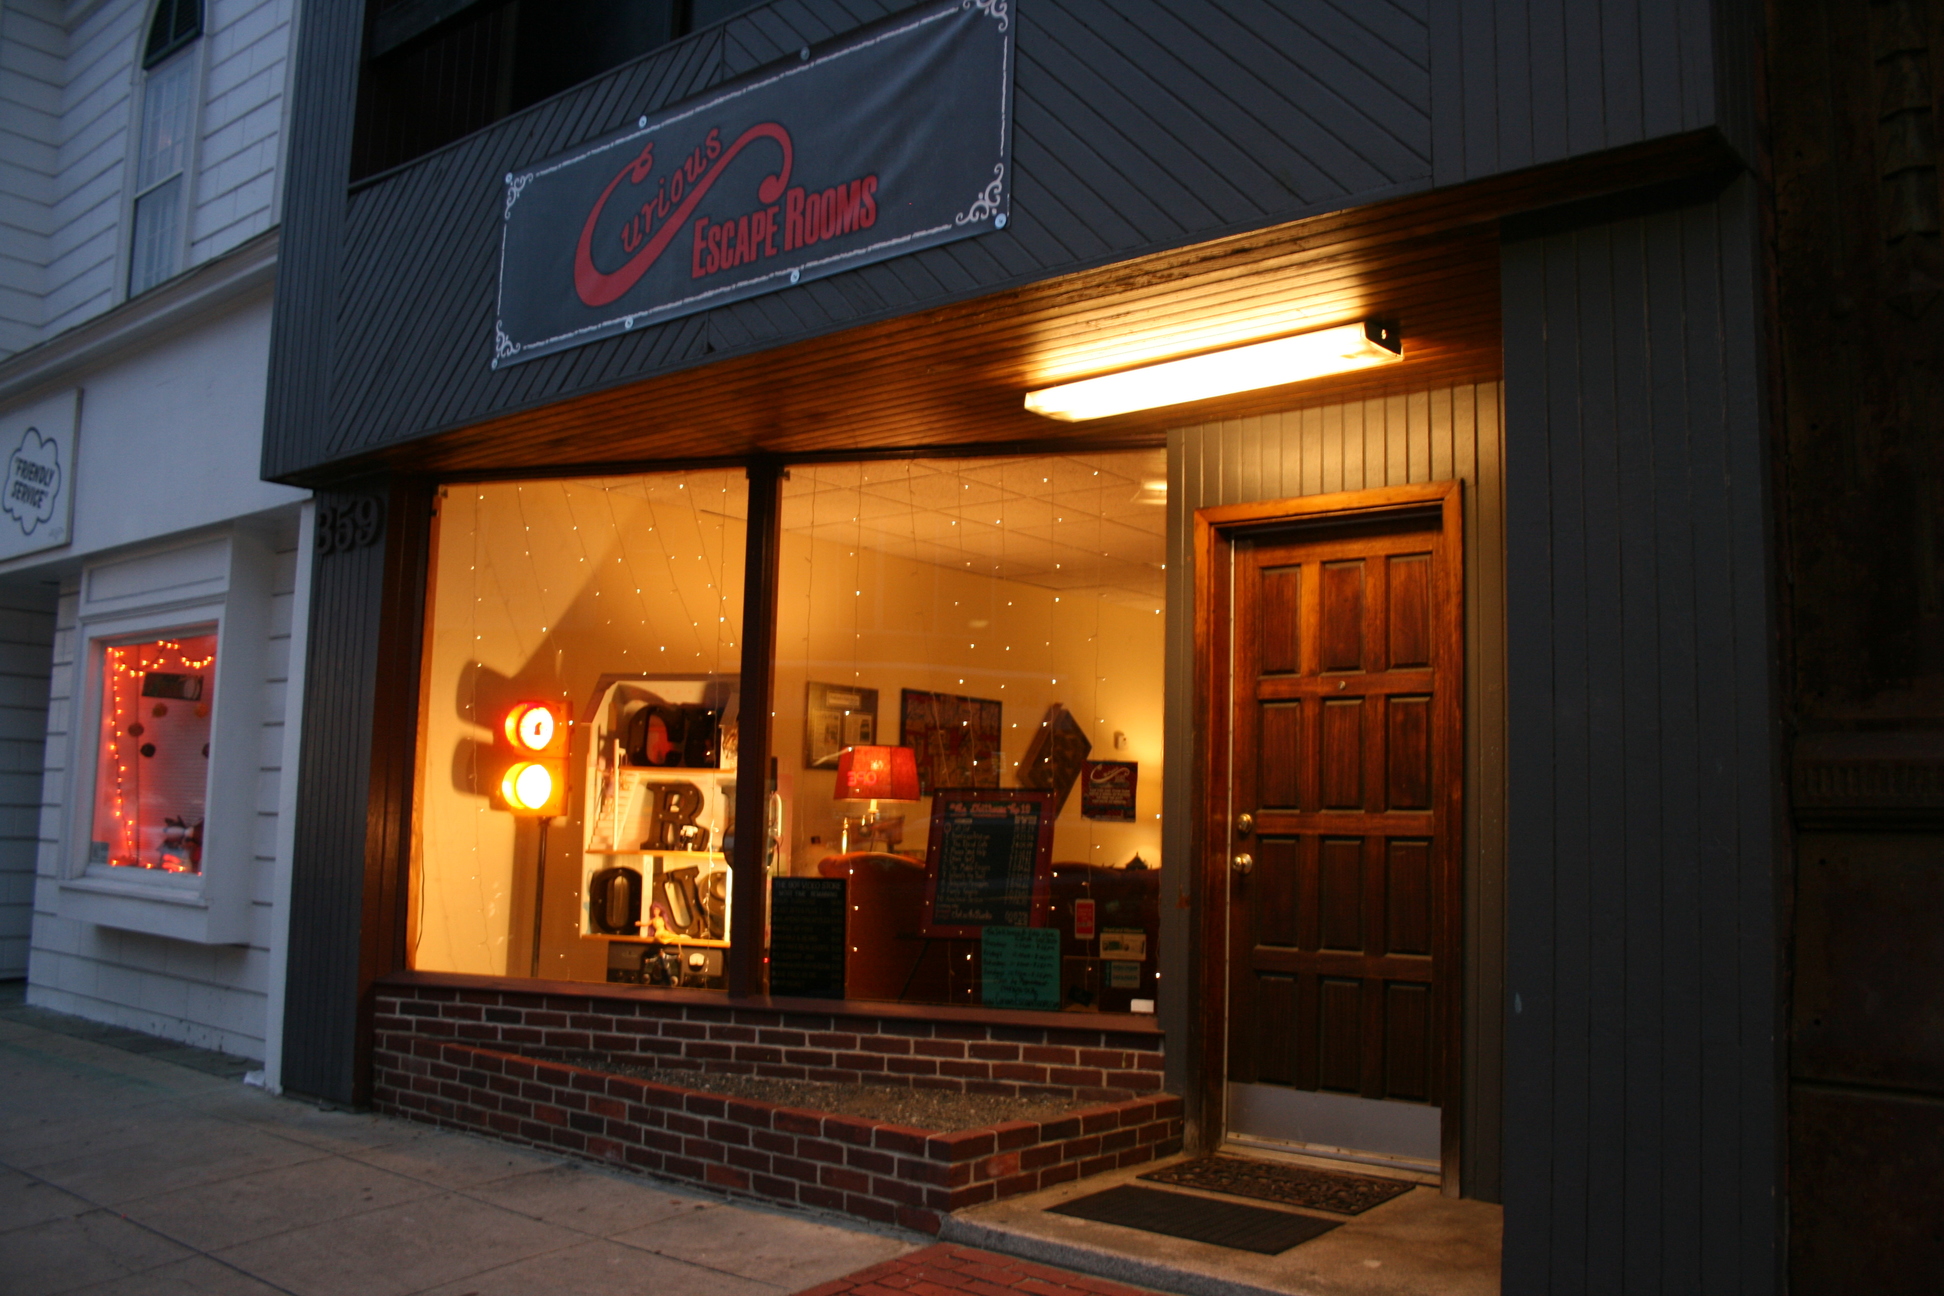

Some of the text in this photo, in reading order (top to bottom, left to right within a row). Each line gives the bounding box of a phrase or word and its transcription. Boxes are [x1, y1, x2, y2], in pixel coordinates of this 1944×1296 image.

[574, 122, 793, 307] Curious
[691, 175, 878, 279] ESCAPE ROOMS
